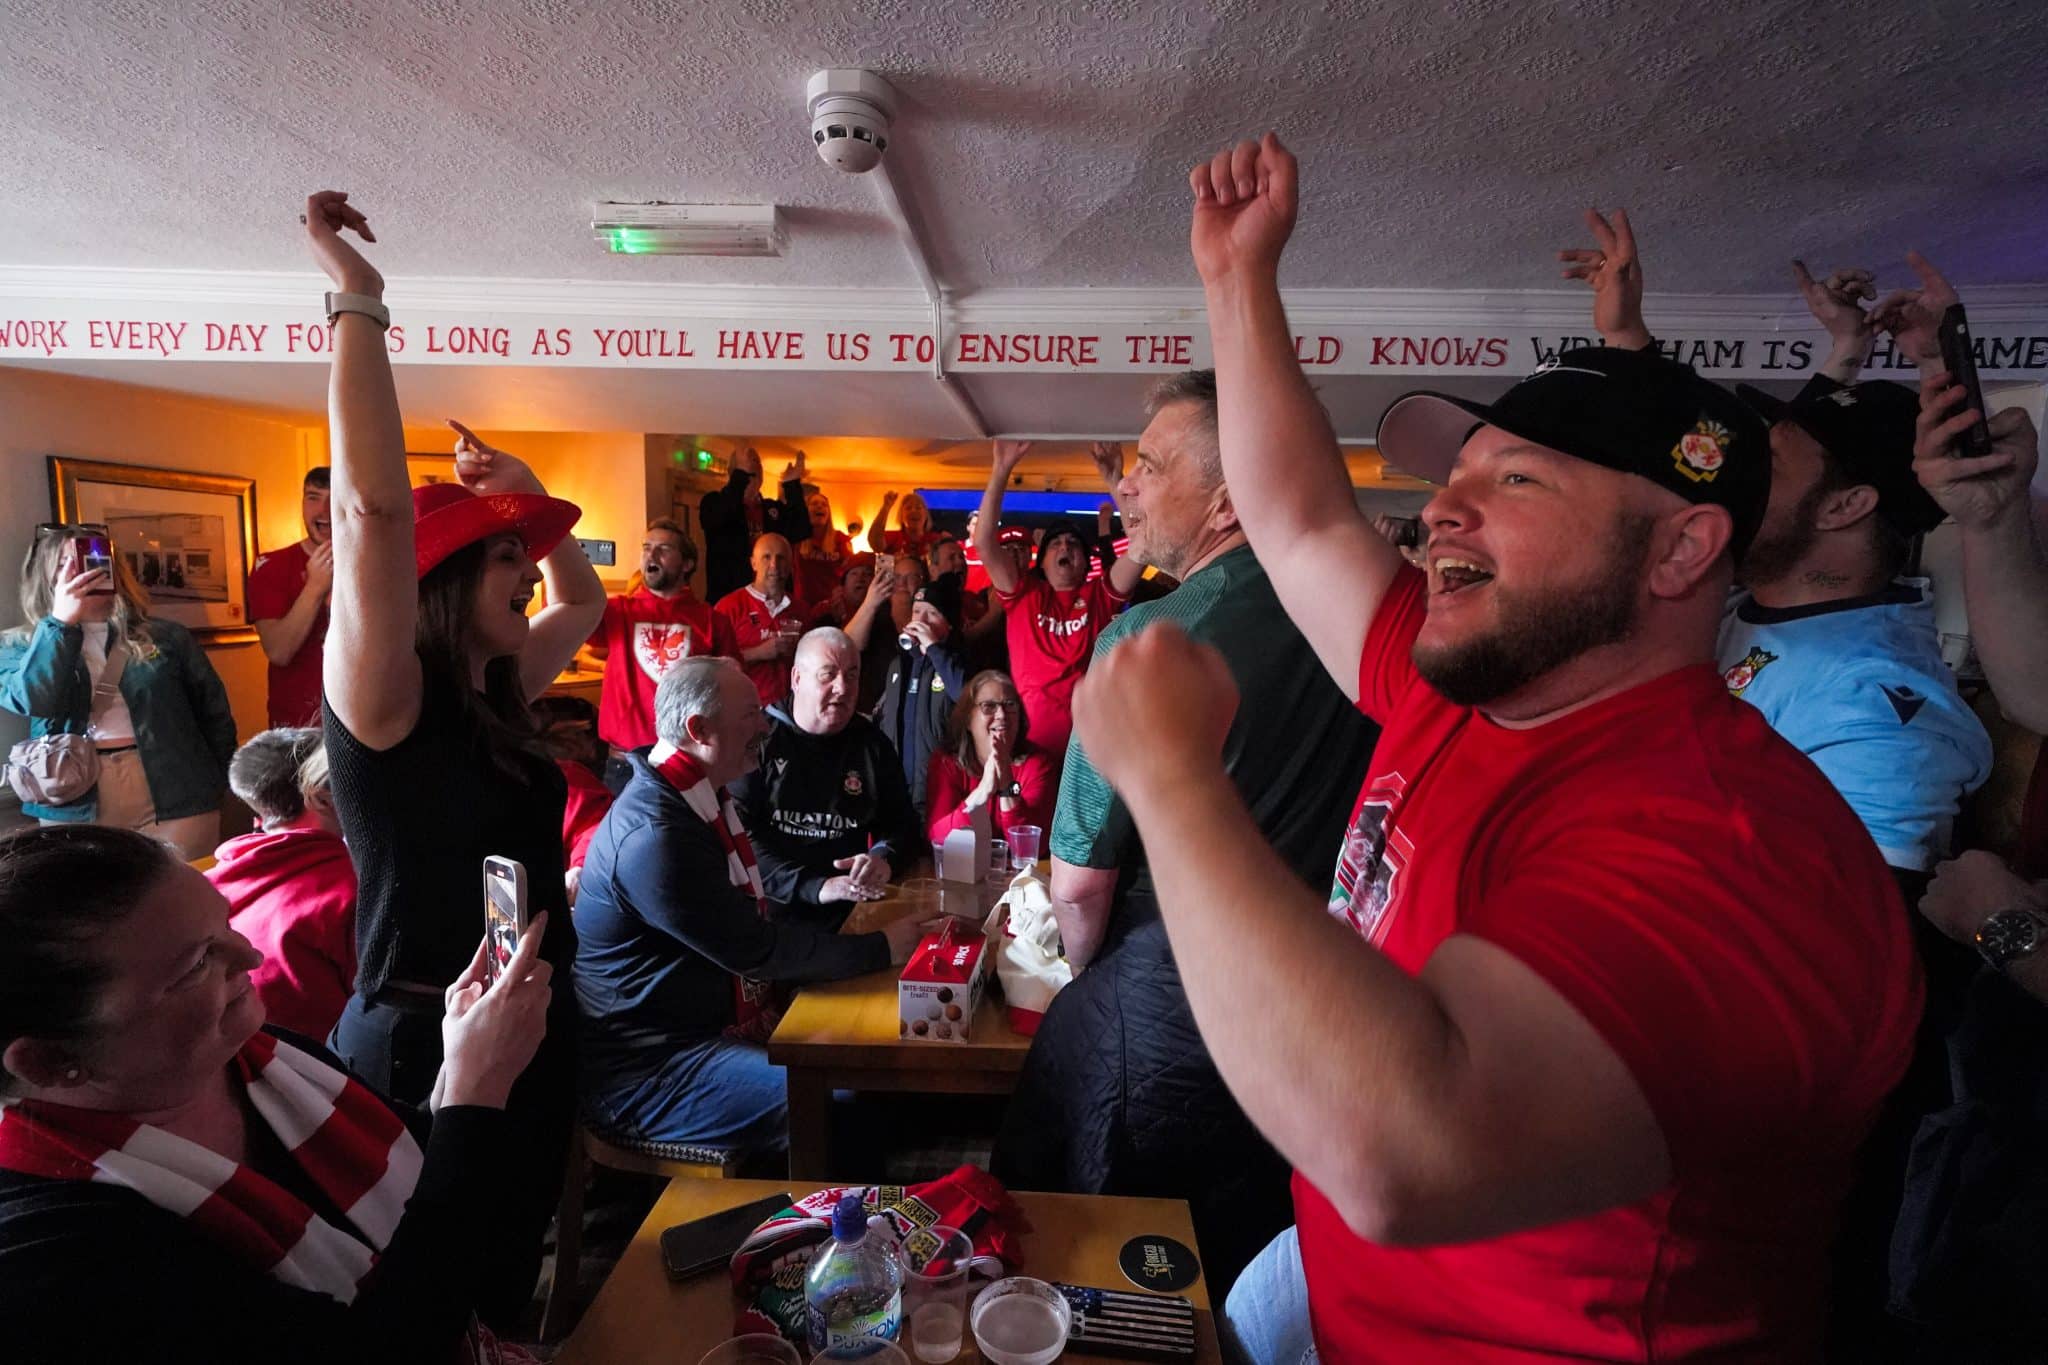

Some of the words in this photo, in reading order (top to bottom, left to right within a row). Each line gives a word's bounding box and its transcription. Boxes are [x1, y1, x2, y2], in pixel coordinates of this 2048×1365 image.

[88, 321, 187, 356] EVERY
[204, 323, 268, 352] DAY
[388, 326, 405, 353] S
[426, 326, 510, 357] LONG
[532, 328, 571, 356] AS
[594, 328, 694, 357] YOU'LL
[717, 331, 804, 359] HAVE
[827, 333, 870, 361] US
[890, 334, 935, 363] TO
[957, 334, 1099, 366] ENSURE
[1126, 336, 1192, 365] THE
[1369, 337, 1509, 367] KNOWS
[1761, 340, 1814, 370] IS
[1969, 337, 2048, 369] AME
